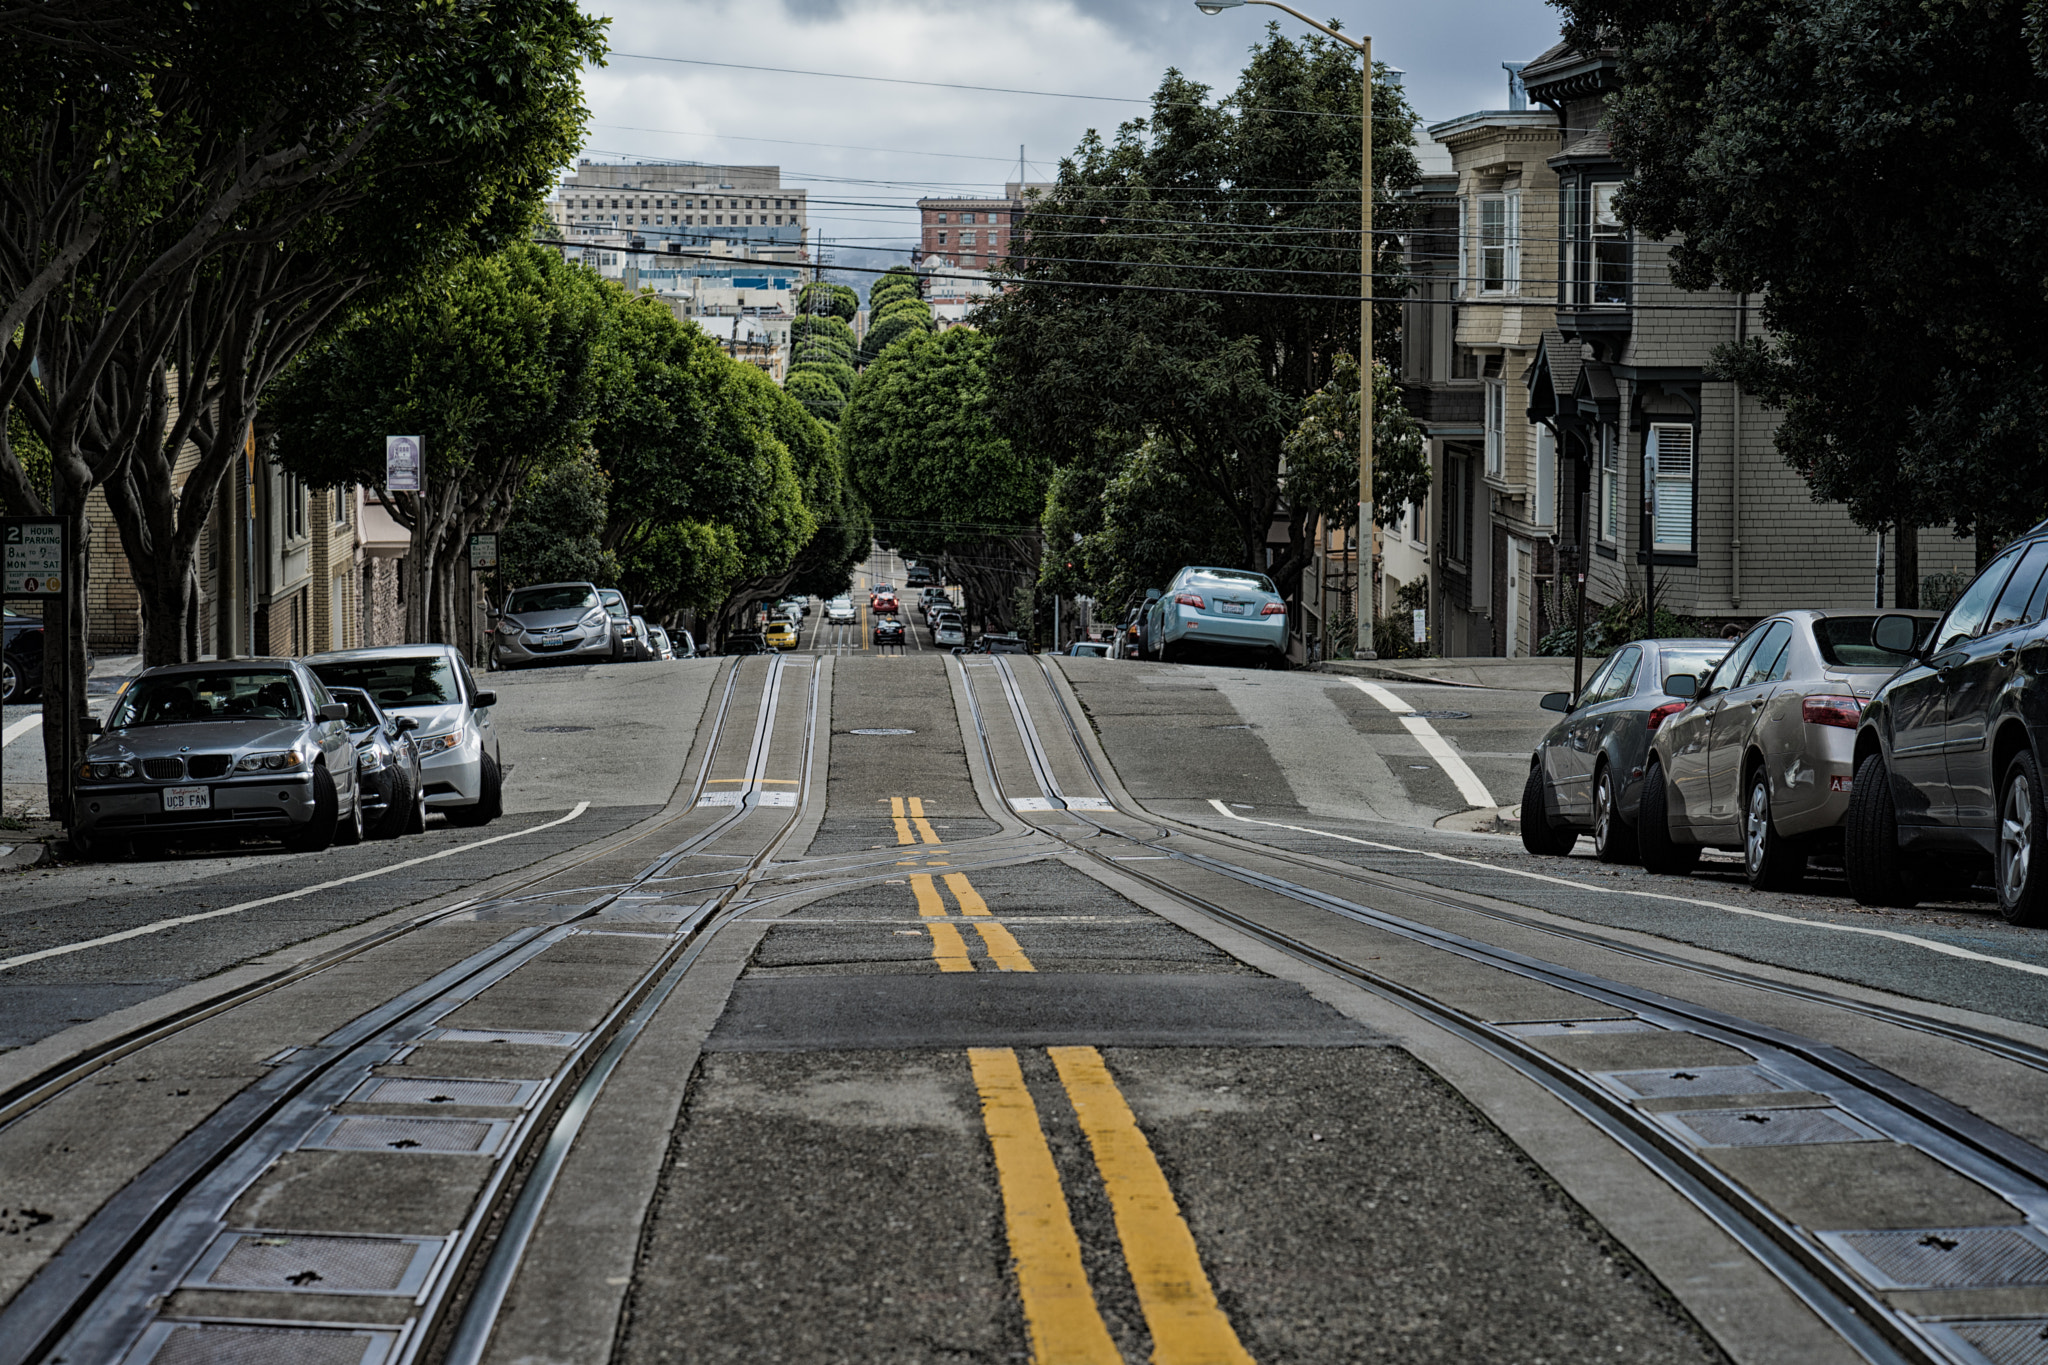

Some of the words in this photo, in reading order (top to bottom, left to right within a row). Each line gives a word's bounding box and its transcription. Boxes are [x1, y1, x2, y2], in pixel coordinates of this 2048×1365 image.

[8, 526, 20, 541] 2
[28, 580, 35, 590] A
[50, 579, 56, 590] C
[1832, 780, 1840, 791] A
[167, 796, 184, 807] UCB
[190, 794, 206, 806] FAN
